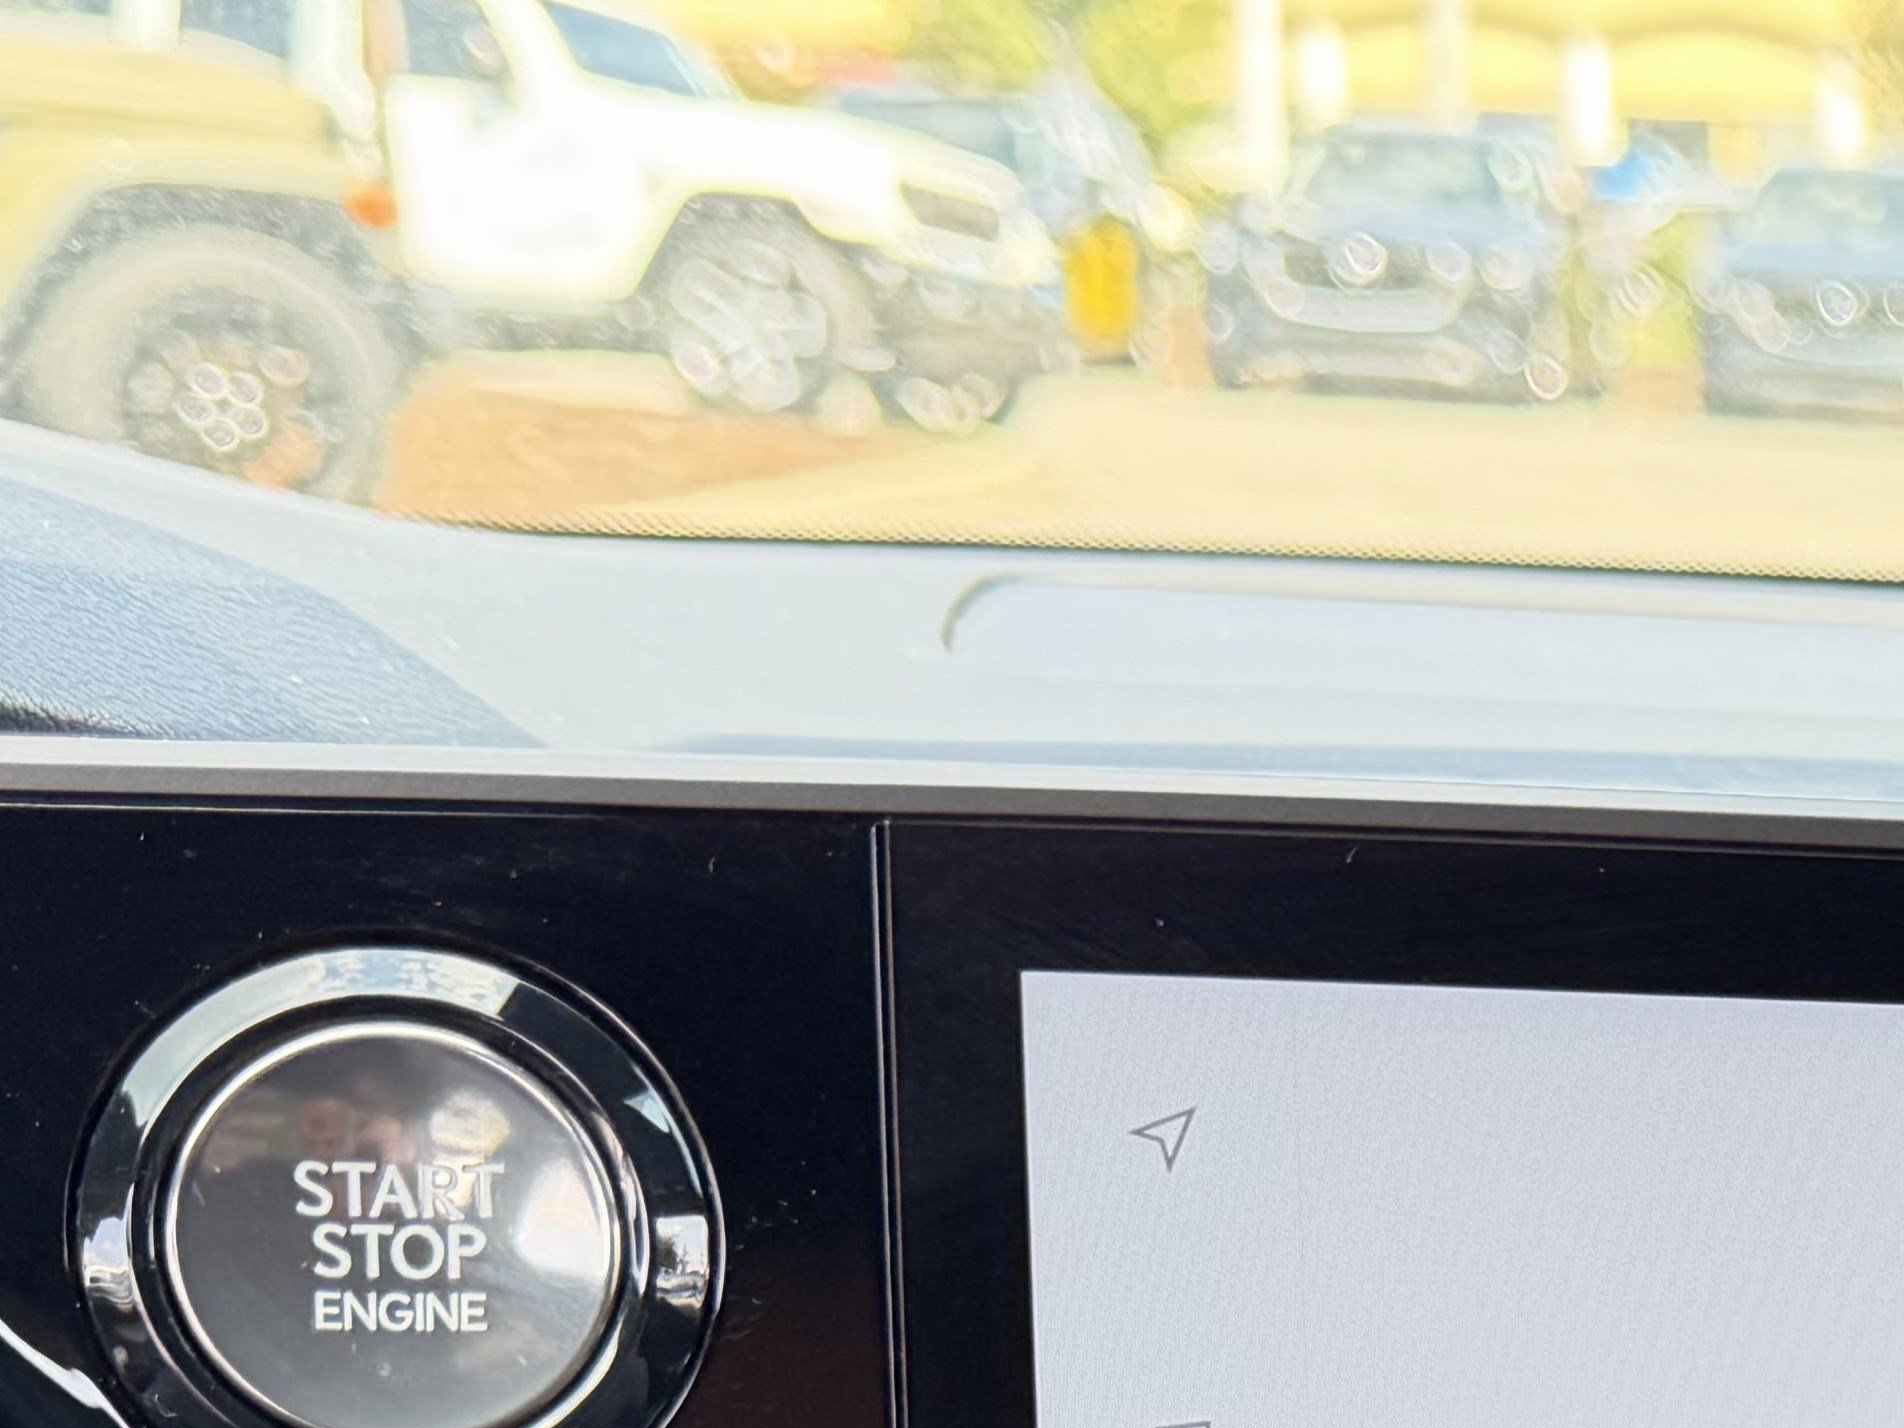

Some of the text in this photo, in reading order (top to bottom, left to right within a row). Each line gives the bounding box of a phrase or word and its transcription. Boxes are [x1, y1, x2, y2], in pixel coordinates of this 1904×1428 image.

[293, 1159, 506, 1220] START
[312, 1222, 488, 1281] STOP
[313, 1291, 489, 1333] ENGINE
